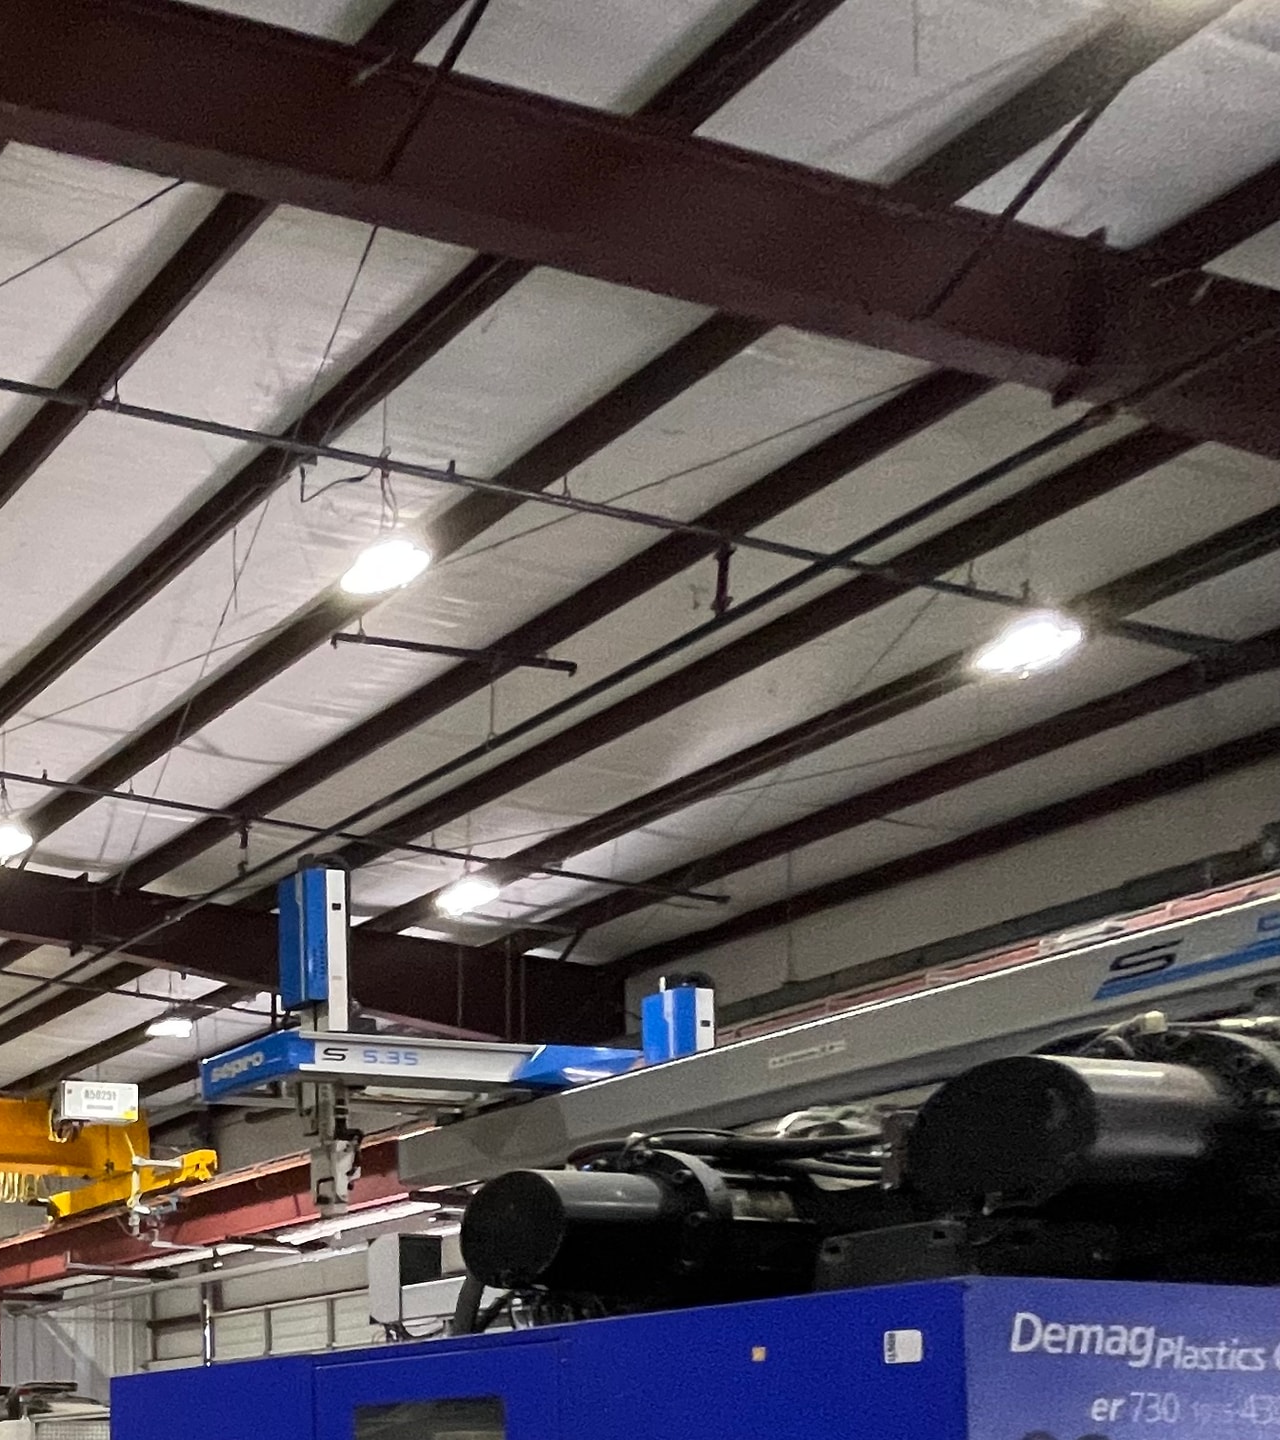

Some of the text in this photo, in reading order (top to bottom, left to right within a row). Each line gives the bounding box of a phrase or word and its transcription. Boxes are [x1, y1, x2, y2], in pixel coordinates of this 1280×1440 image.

[1102, 937, 1184, 985] S
[322, 1047, 419, 1066] S 5.35
[1010, 1311, 1156, 1368] Demag
[1154, 1335, 1267, 1372] Plastics
